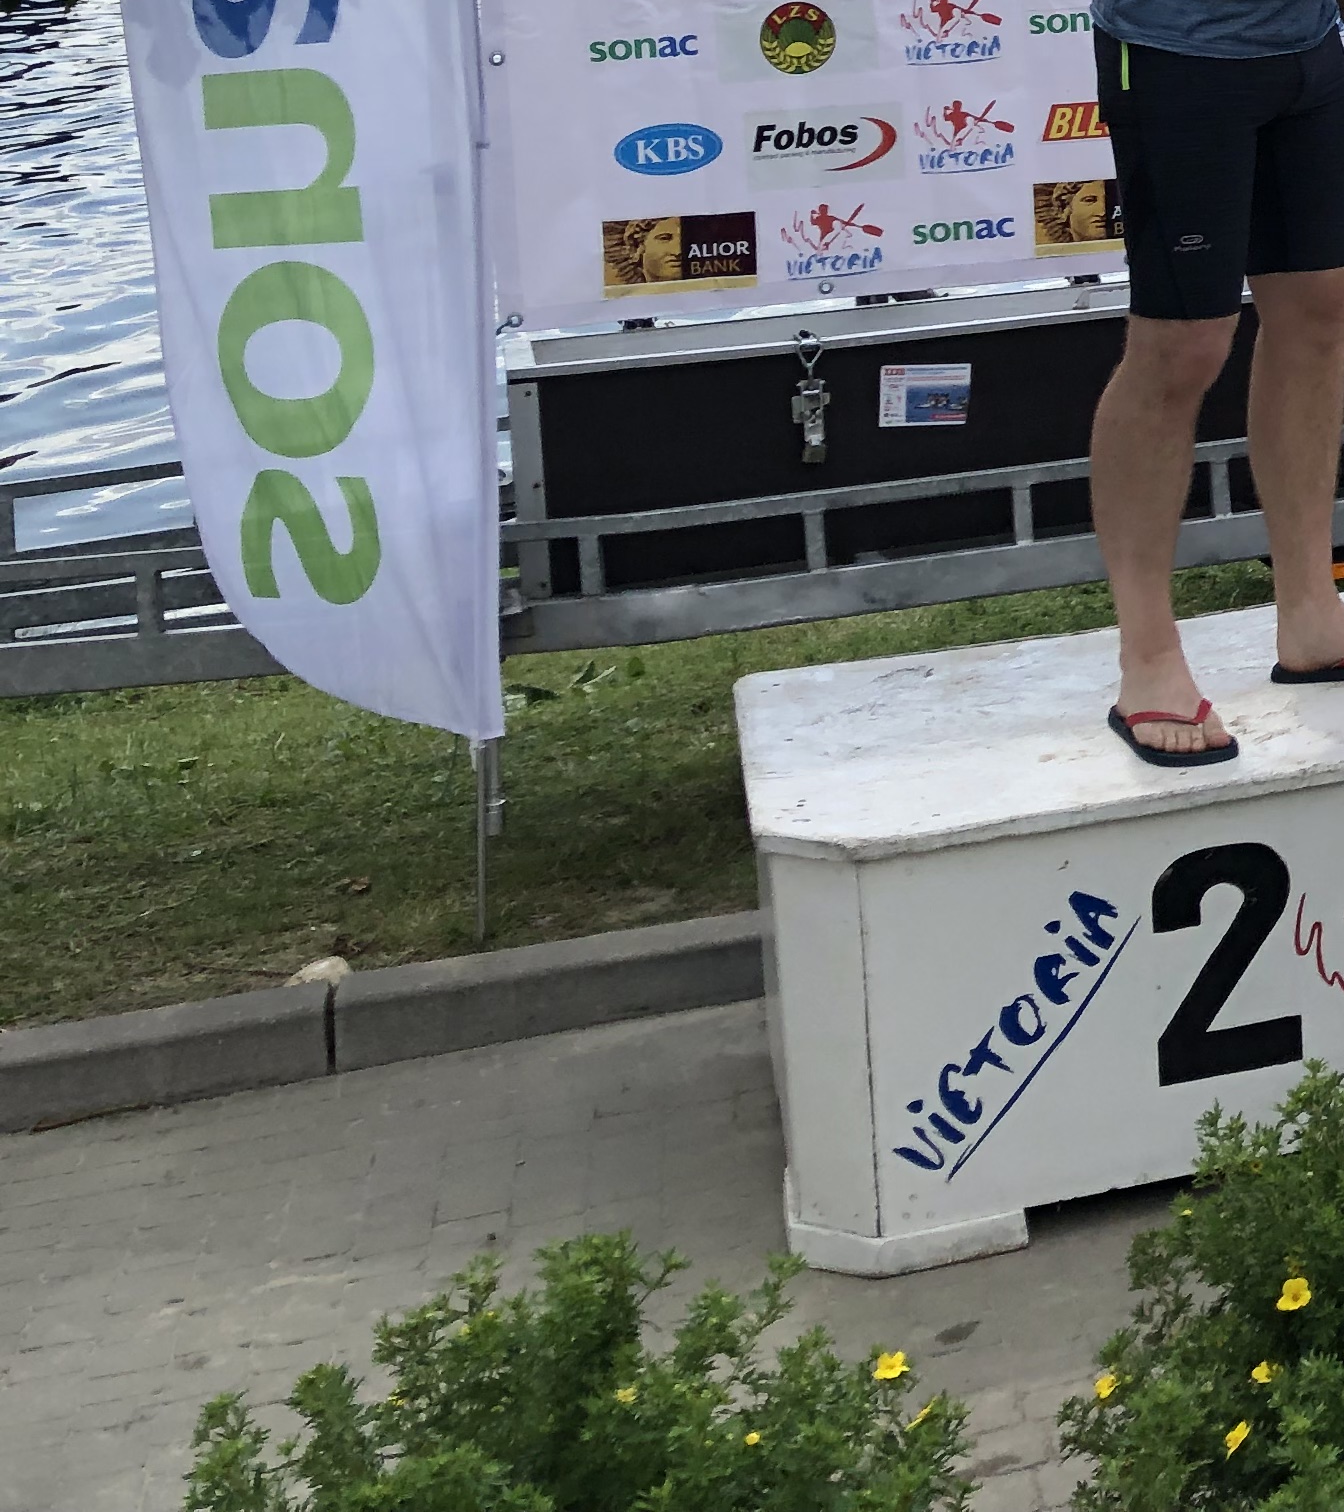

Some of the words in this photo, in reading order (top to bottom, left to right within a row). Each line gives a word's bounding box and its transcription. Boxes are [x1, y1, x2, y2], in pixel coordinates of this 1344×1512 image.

[772, 5, 819, 25] LZS
[1029, 12, 1093, 34] son
[589, 34, 699, 62] sonac
[635, 135, 705, 165] KBS
[753, 121, 859, 153] Fobos
[912, 217, 1015, 245] sonac
[688, 240, 750, 258] ALIOR
[690, 259, 740, 276] BANK
[1152, 843, 1302, 1087] 2
